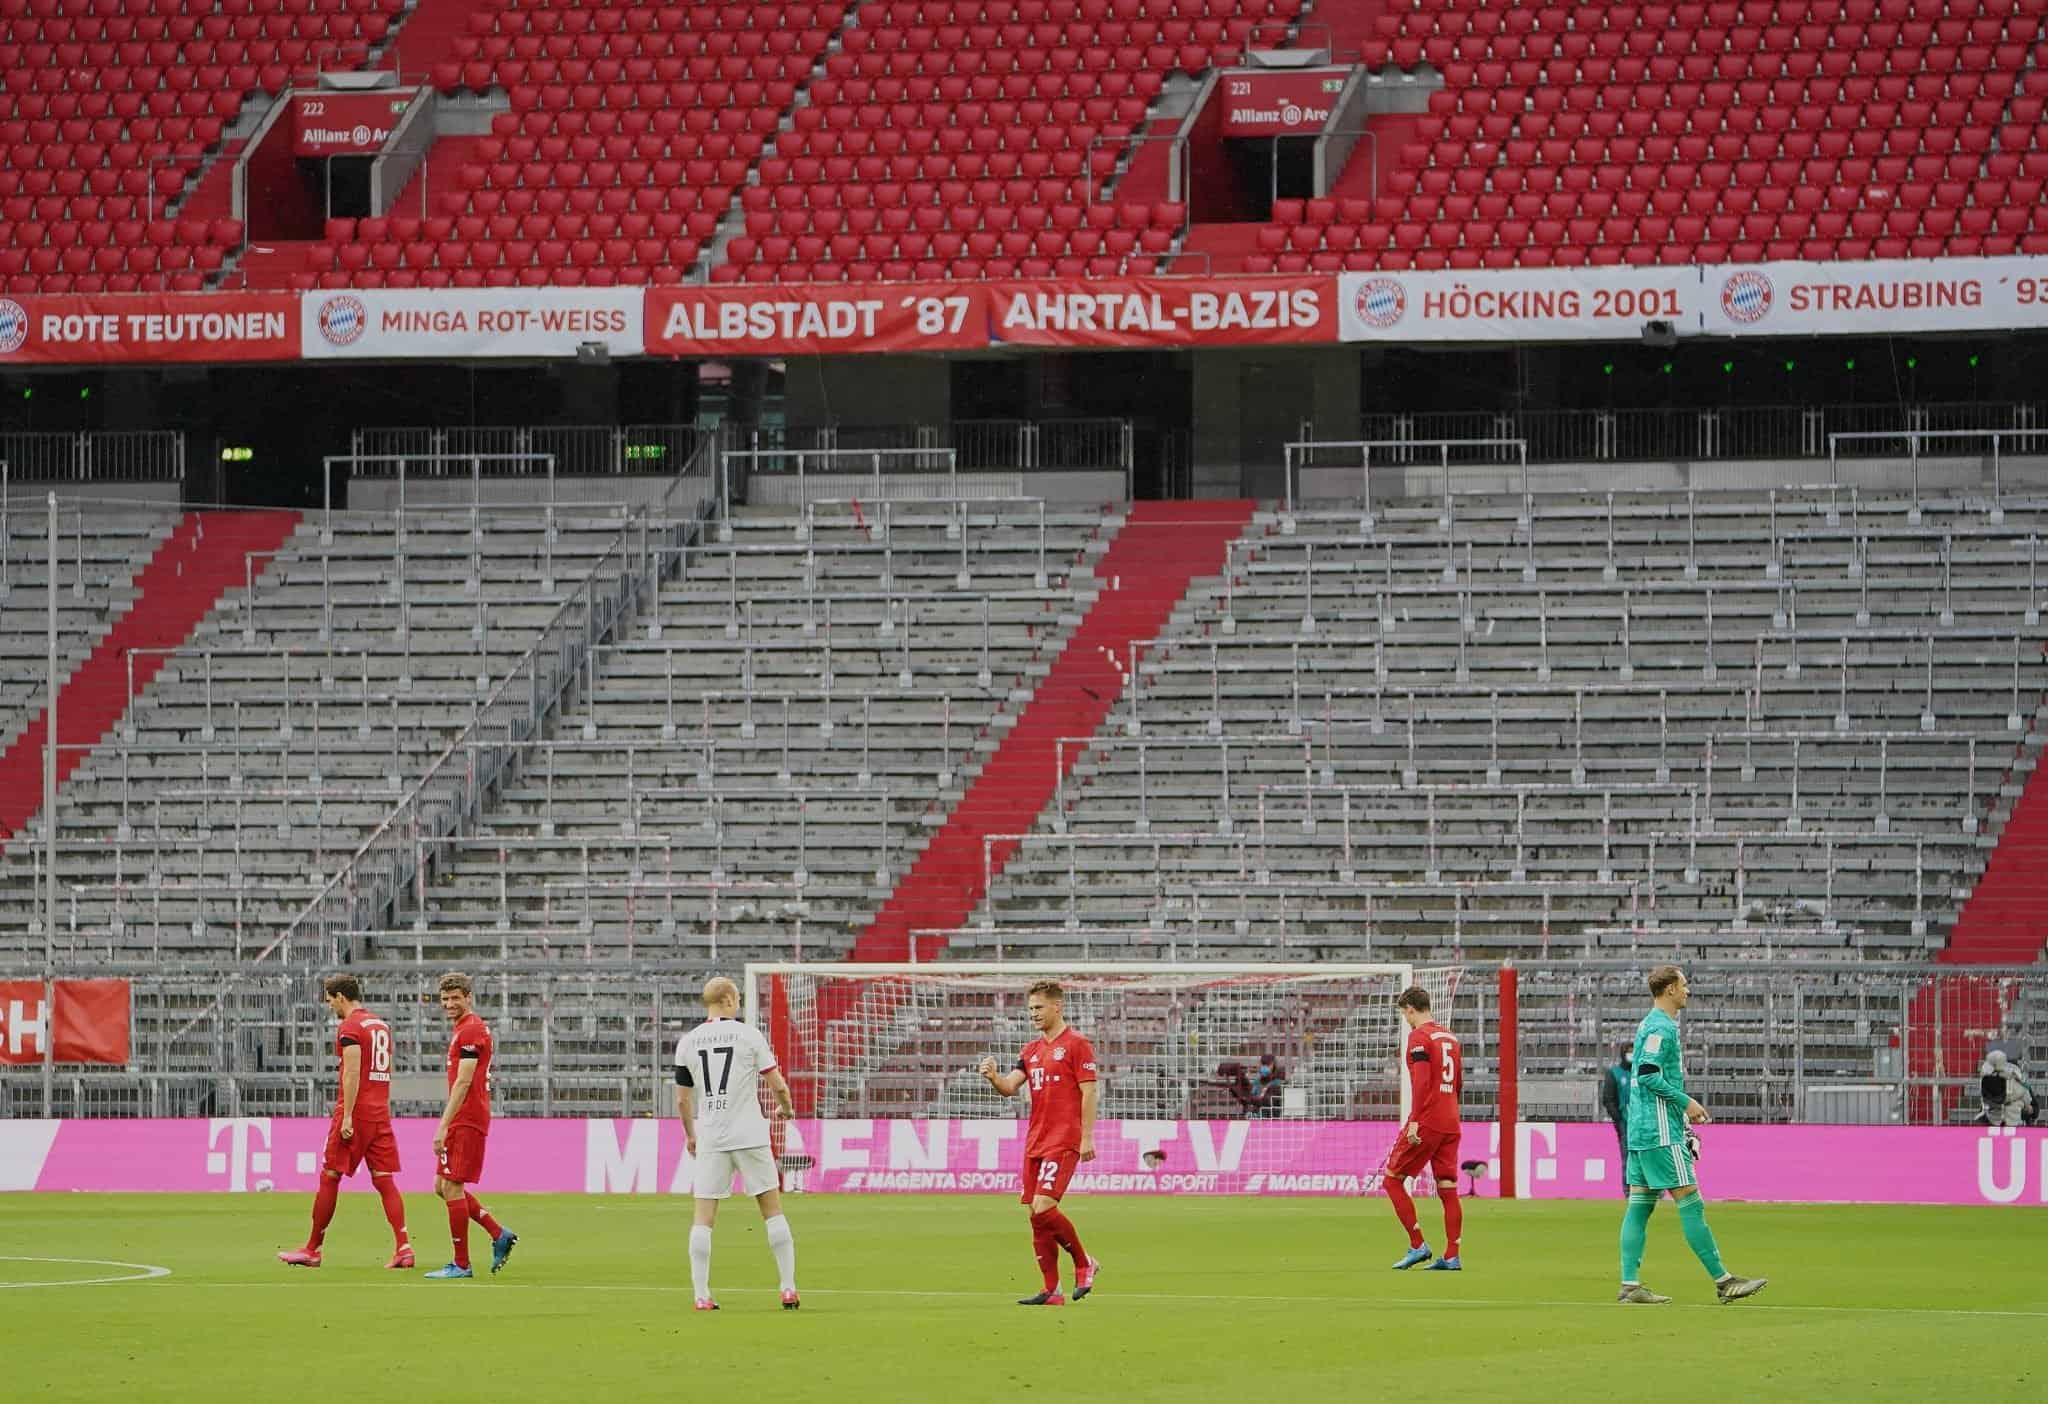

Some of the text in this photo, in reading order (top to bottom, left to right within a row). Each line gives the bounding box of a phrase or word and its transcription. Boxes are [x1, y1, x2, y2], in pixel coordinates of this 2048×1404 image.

[1231, 82, 1251, 95] 221
[303, 102, 325, 115] 222
[1231, 109, 1281, 122] Allianz
[303, 128, 351, 142] Allianz
[1003, 289, 1320, 331] AHRTAL-BAZIS
[1423, 283, 1580, 318] HÖCKING
[1592, 288, 1684, 317] 2001
[1789, 280, 1983, 311] STRAUBING
[42, 314, 120, 342] ROTE
[127, 312, 286, 342] TEUTONEN
[381, 310, 468, 332] MINGA
[478, 309, 627, 332] ROT-WEISS
[661, 300, 884, 339] ALBSTADT
[0, 999, 46, 1055] H
[370, 1028, 390, 1072] 18
[1441, 1041, 1455, 1083] 5
[697, 1046, 734, 1097] 17
[1120, 1119, 1251, 1171] TV
[867, 1172, 1019, 1190] MAGENTA SPORT
[1160, 1174, 1219, 1192] SPORT
[1268, 1174, 1359, 1192] MAGENTA
